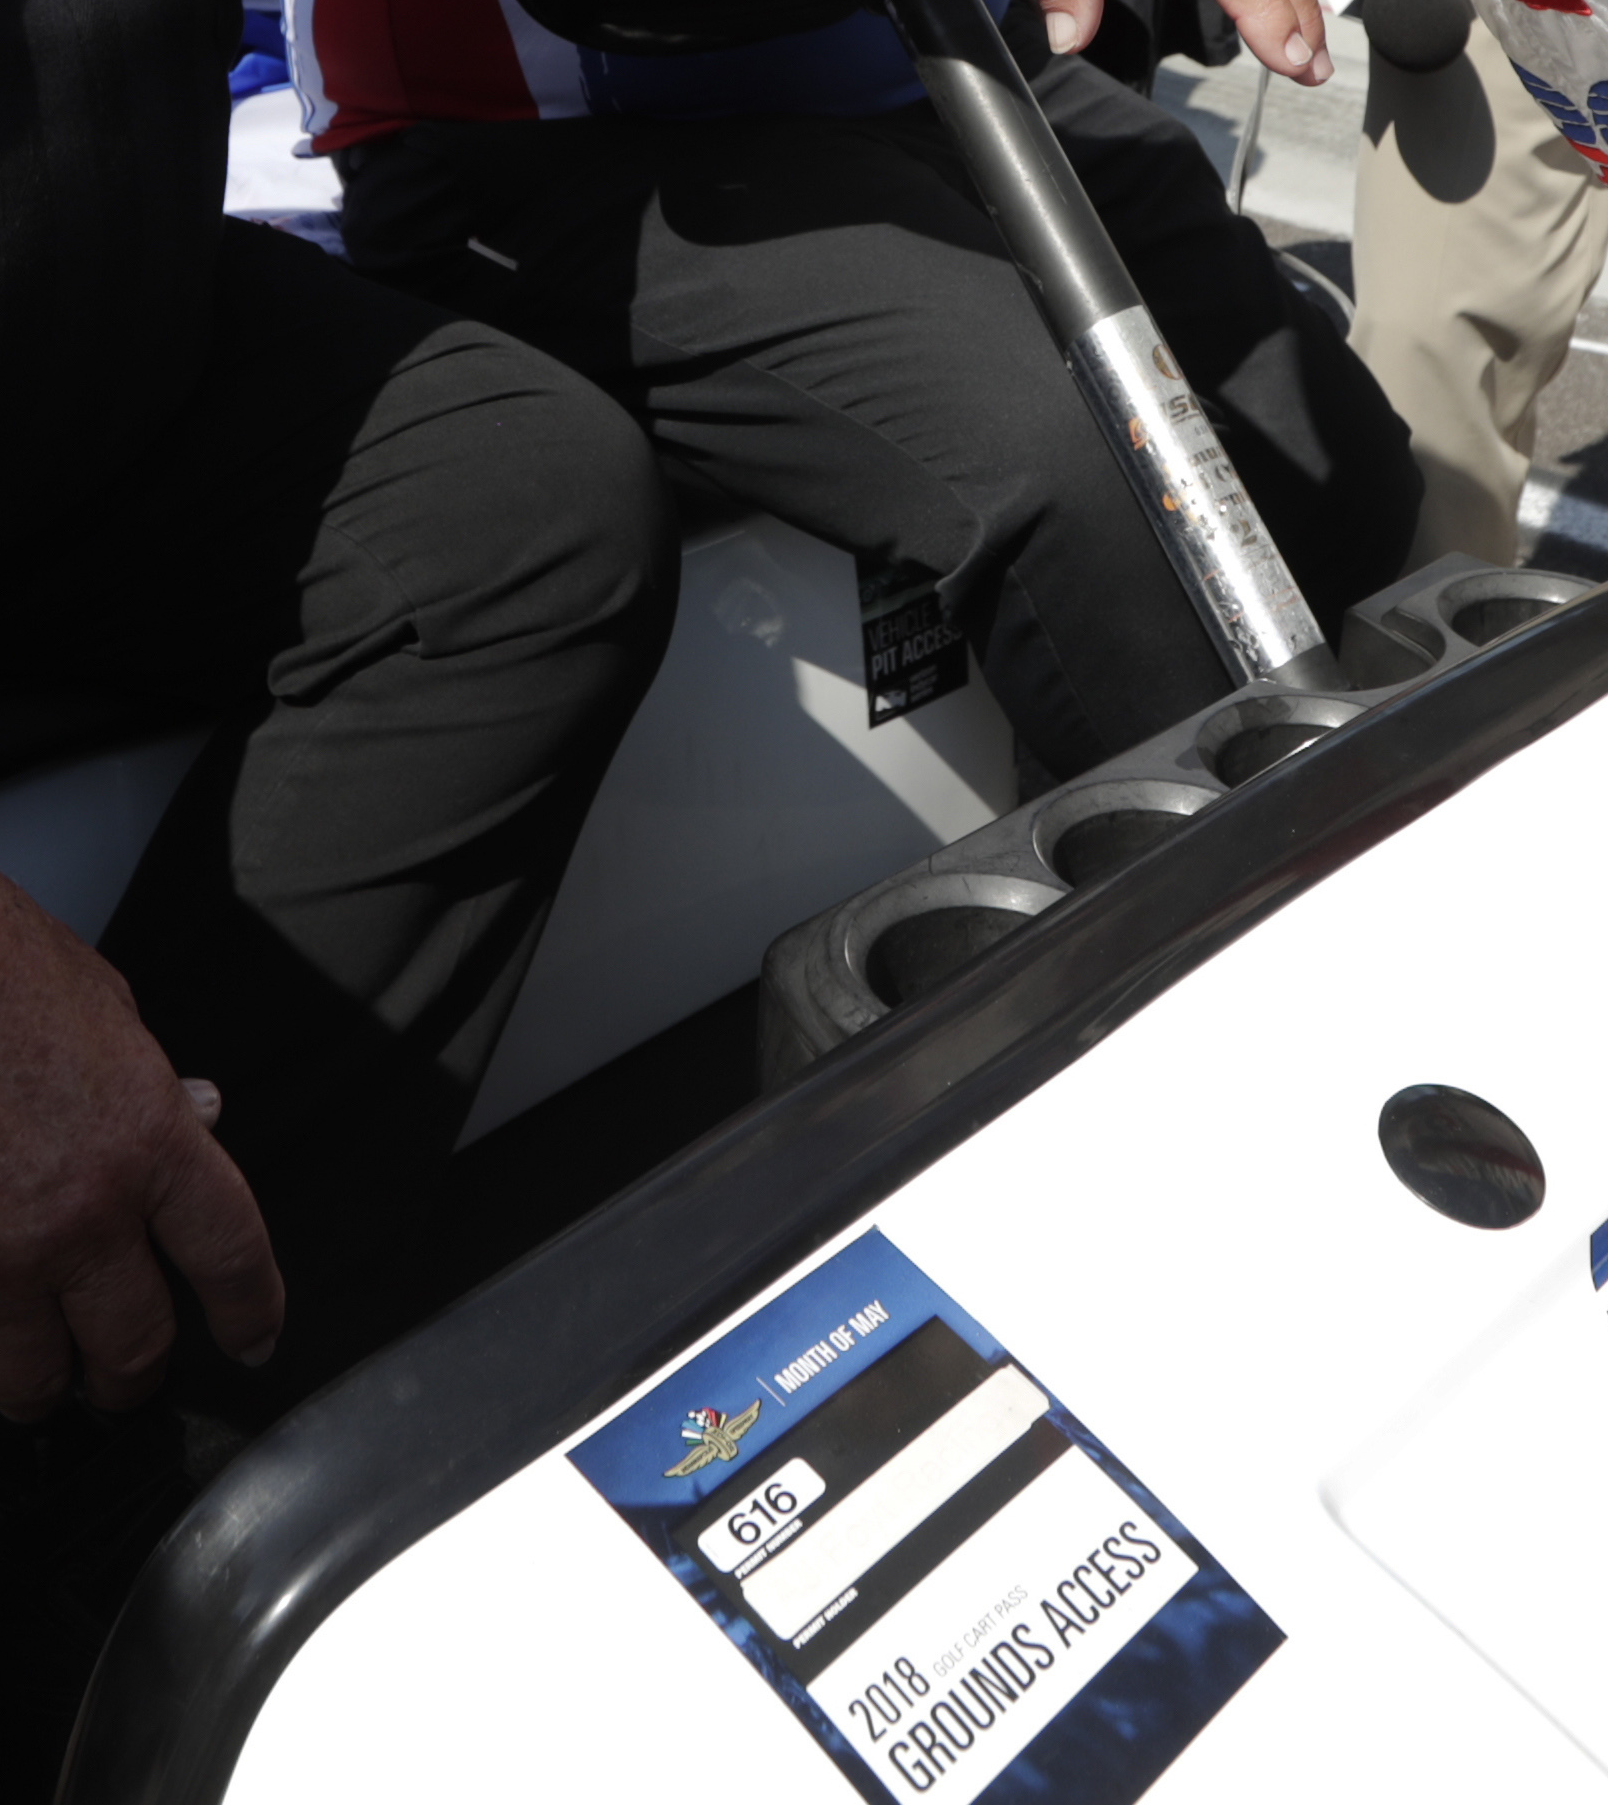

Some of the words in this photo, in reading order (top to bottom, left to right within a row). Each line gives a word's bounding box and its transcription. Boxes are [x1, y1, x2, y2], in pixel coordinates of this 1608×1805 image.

[871, 646, 899, 682] PIT
[773, 1339, 839, 1395] MONTH
[828, 1323, 857, 1353] OF
[847, 1298, 890, 1338] MAY
[726, 1482, 799, 1547] 616
[848, 1656, 931, 1744] 2018
[933, 1641, 965, 1678] GOLF
[962, 1611, 999, 1650] CART
[994, 1583, 1030, 1620] PASS
[887, 1622, 1056, 1794] GROUNDS
[1039, 1520, 1163, 1650] ACCESS
